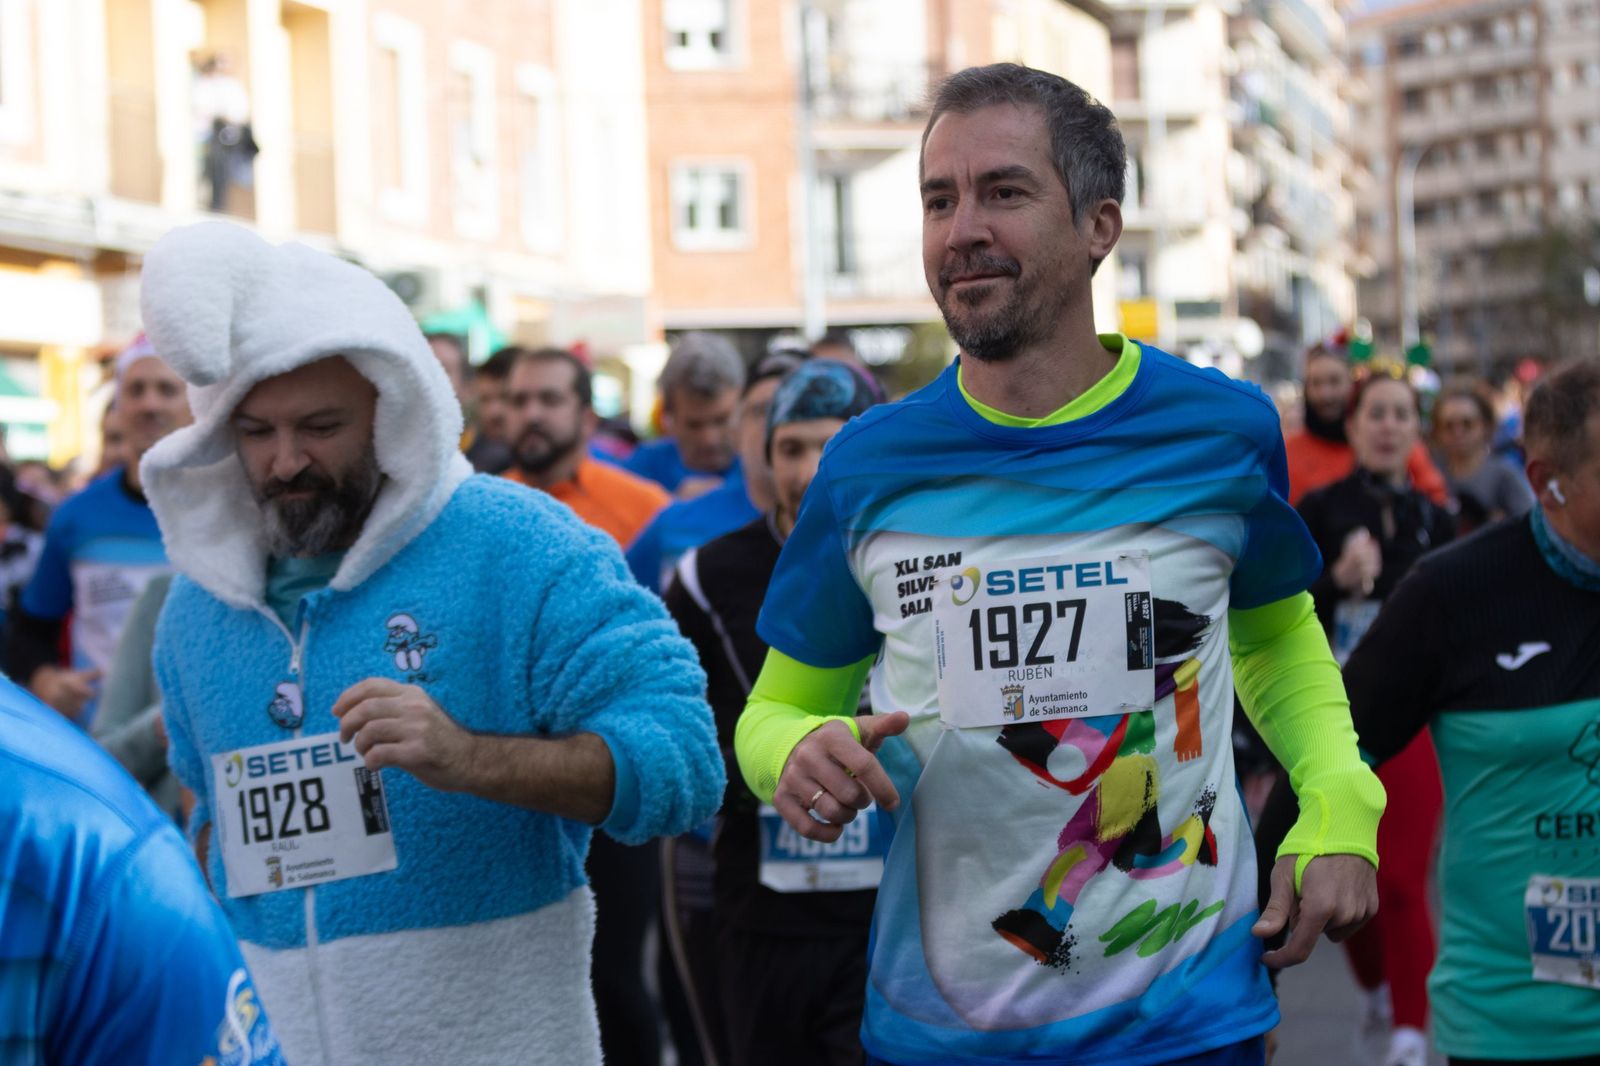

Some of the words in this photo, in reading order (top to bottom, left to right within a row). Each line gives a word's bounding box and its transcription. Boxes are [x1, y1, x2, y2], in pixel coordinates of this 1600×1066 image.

[894, 557, 919, 578] XLI
[923, 551, 962, 571] SAN
[986, 561, 1128, 597] SETEL
[969, 598, 1087, 671] 1927
[1007, 666, 1053, 682] RUBÉN
[1028, 690, 1088, 705] Ayuntamiento
[1029, 707, 1040, 717] de
[1042, 704, 1088, 716] Salamanca
[247, 742, 355, 778] SETEL
[238, 777, 331, 845] 1928
[1535, 812, 1600, 840] CER
[776, 808, 869, 858] 49
[1547, 908, 1600, 952] 20
